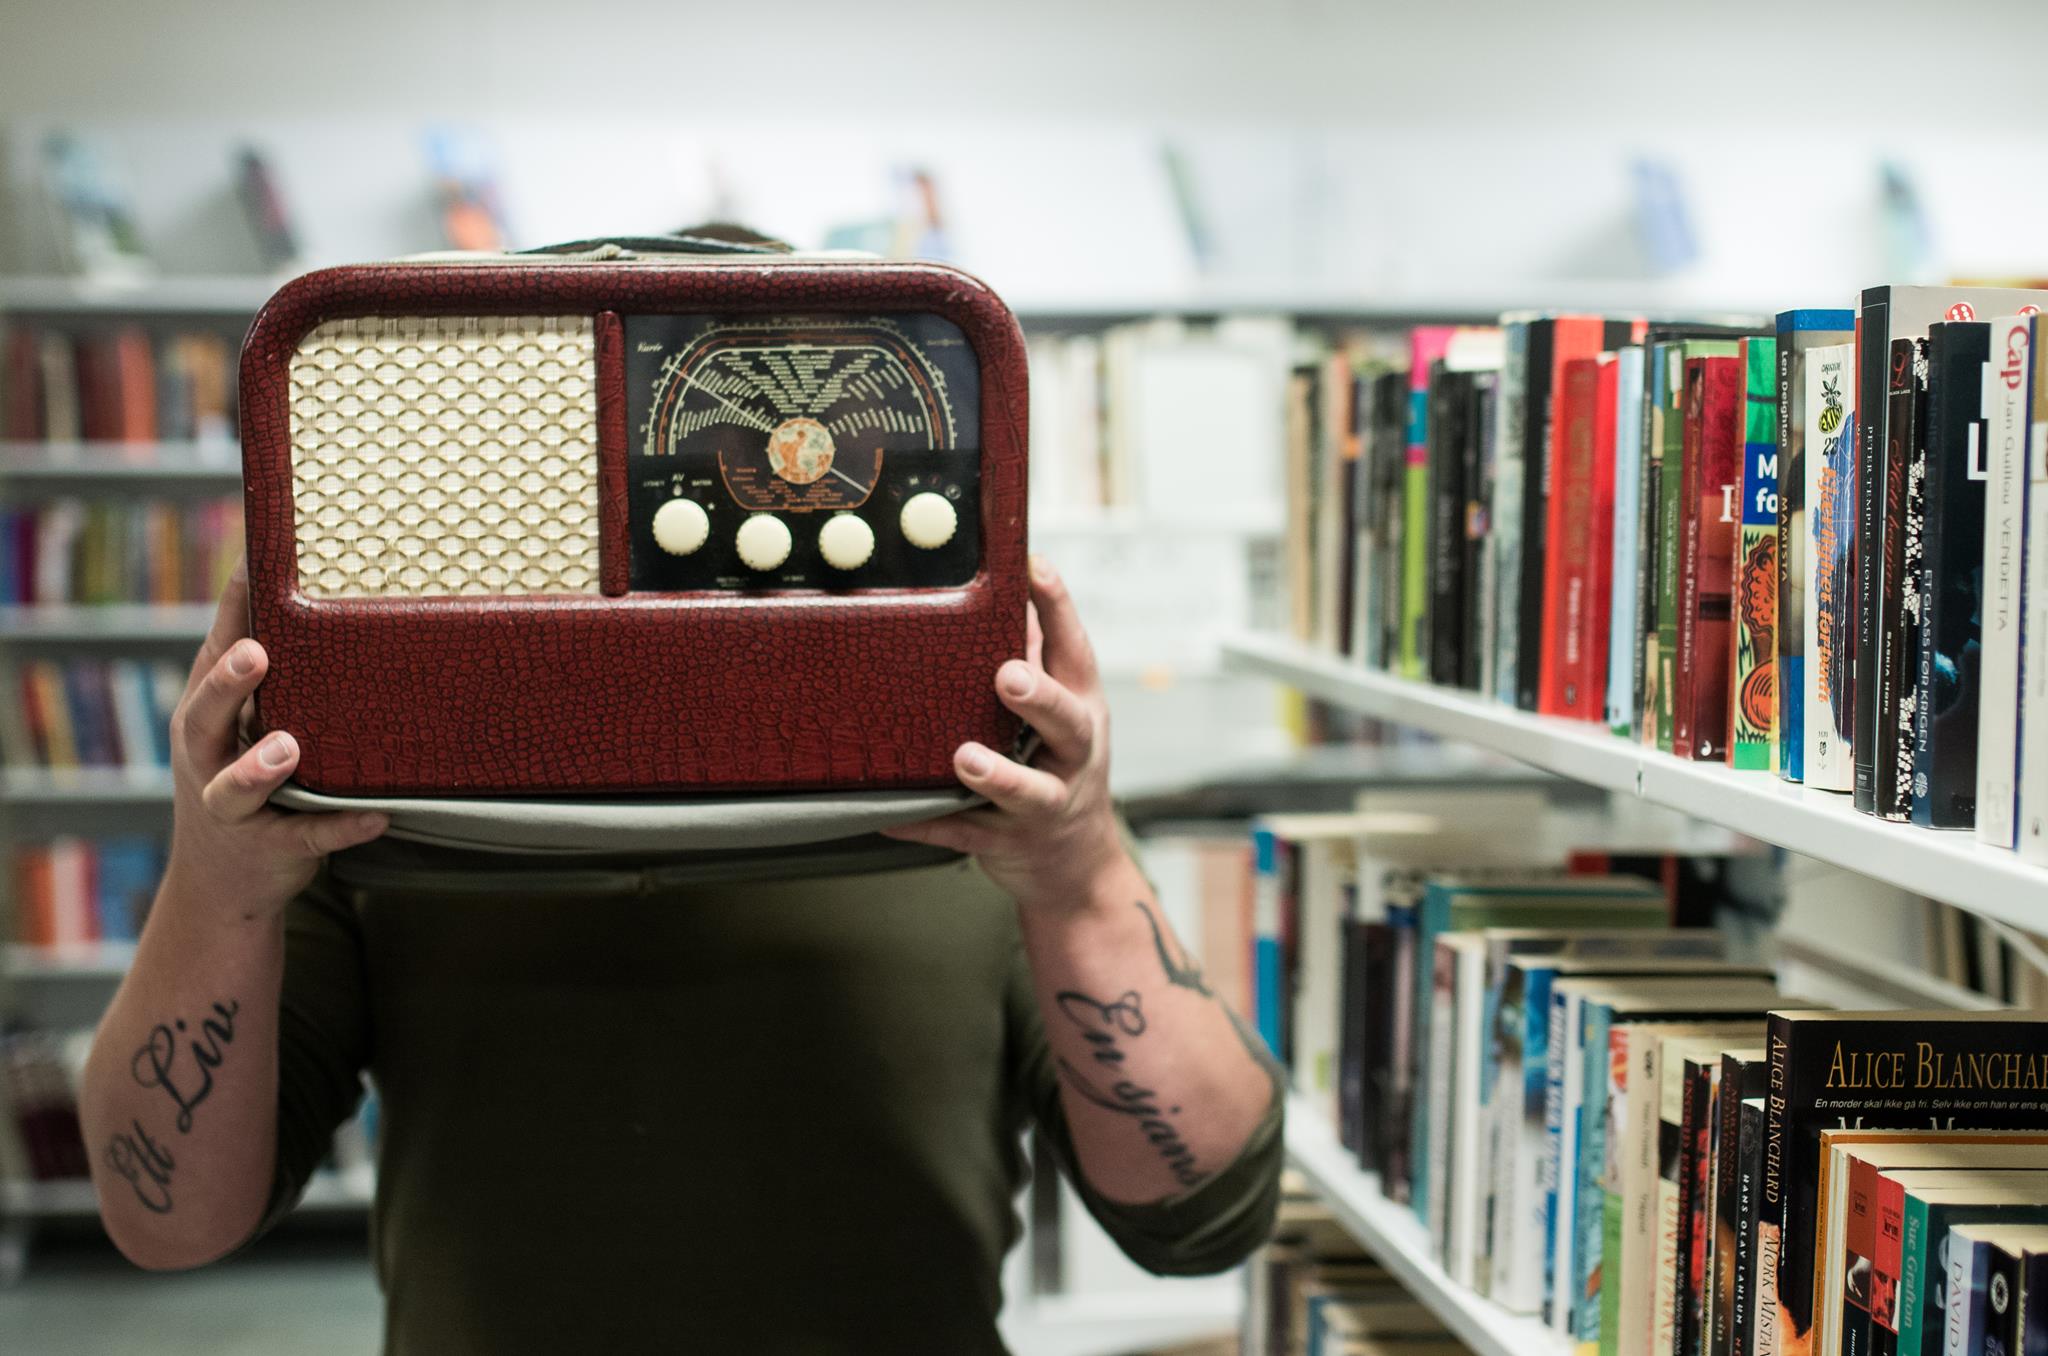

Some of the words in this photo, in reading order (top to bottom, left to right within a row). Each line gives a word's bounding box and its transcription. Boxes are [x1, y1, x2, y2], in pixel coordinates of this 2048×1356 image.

[1781, 350, 1790, 378] Len
[2001, 326, 2030, 390] Cap
[1780, 381, 1790, 448] Deighton
[2004, 393, 2016, 430] Jan
[1822, 436, 1840, 456] 22
[1865, 426, 1874, 474] PETER
[2002, 436, 2015, 504] Guillou
[1813, 466, 1838, 603] Kjærlighet
[1865, 478, 1873, 540] TEMPLE
[1780, 496, 1789, 582] MAMISTA
[1863, 555, 1871, 602] MØRK
[1924, 569, 1933, 590] ET
[1997, 517, 2012, 631] VENDETTA
[1862, 607, 1870, 647] KYST
[1922, 593, 1933, 648] GLASS
[1817, 610, 1835, 704] forbudt
[1884, 631, 1892, 677] SASKIA
[1920, 651, 1931, 686] FØR
[1918, 690, 1929, 753] KRIGEN
[131, 1000, 239, 1134] Liv
[1770, 1034, 1787, 1090] ALICE
[1825, 1039, 1906, 1089] ALICE
[1815, 1098, 1828, 1109] En
[1829, 1098, 1862, 1109] morder
[1863, 1099, 1882, 1109] skal
[1884, 1099, 1902, 1109] ikke
[1904, 1099, 1916, 1111] gå
[1918, 1099, 1929, 1109] fri.
[1931, 1099, 1951, 1110] Selv
[1953, 1099, 1972, 1110] ikke
[1973, 1101, 1988, 1110] om
[1990, 1100, 2007, 1110] han
[2009, 1102, 2020, 1110] er
[2021, 1102, 2038, 1111] ens
[1765, 1093, 1786, 1203] BLANCHARD
[1741, 1173, 1750, 1213] HANS
[1739, 1220, 1749, 1259] OLAV
[1908, 1215, 1920, 1251] Sue
[1904, 1255, 1919, 1329] Grafton
[1950, 1261, 1963, 1348] DAVID
